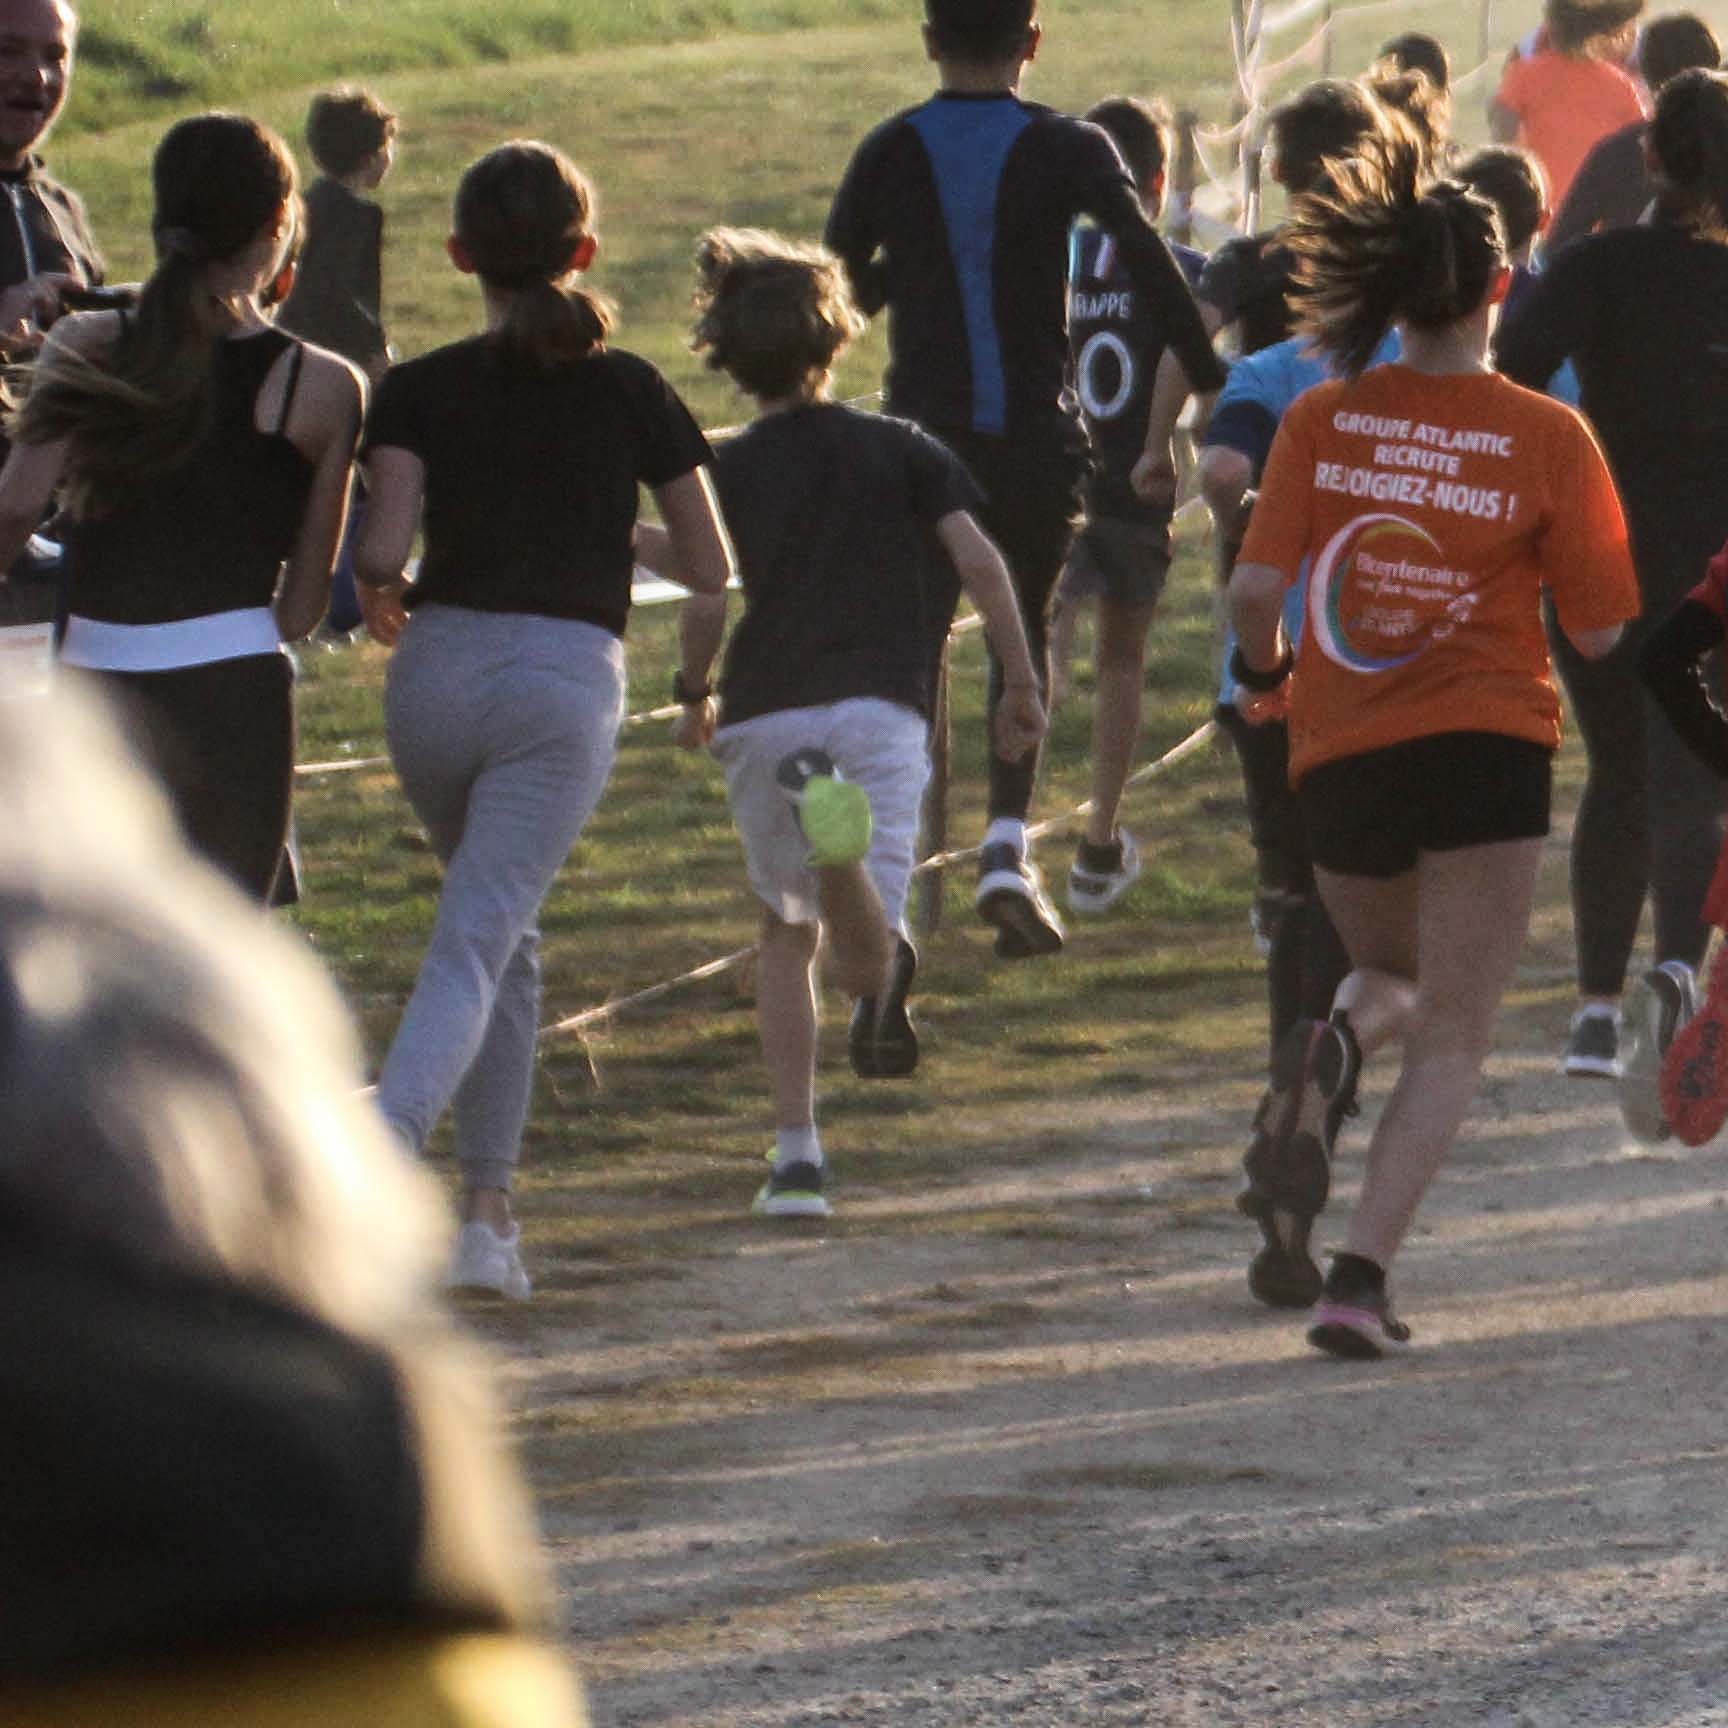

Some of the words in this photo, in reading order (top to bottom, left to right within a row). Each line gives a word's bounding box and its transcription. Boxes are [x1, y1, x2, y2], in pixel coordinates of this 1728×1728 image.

[1333, 410, 1412, 439] GROUPE
[1412, 423, 1513, 458] ATLANTIC
[1374, 444, 1461, 476] RECRUTE
[1314, 461, 1500, 519] REJOIGNEZ-NOUS
